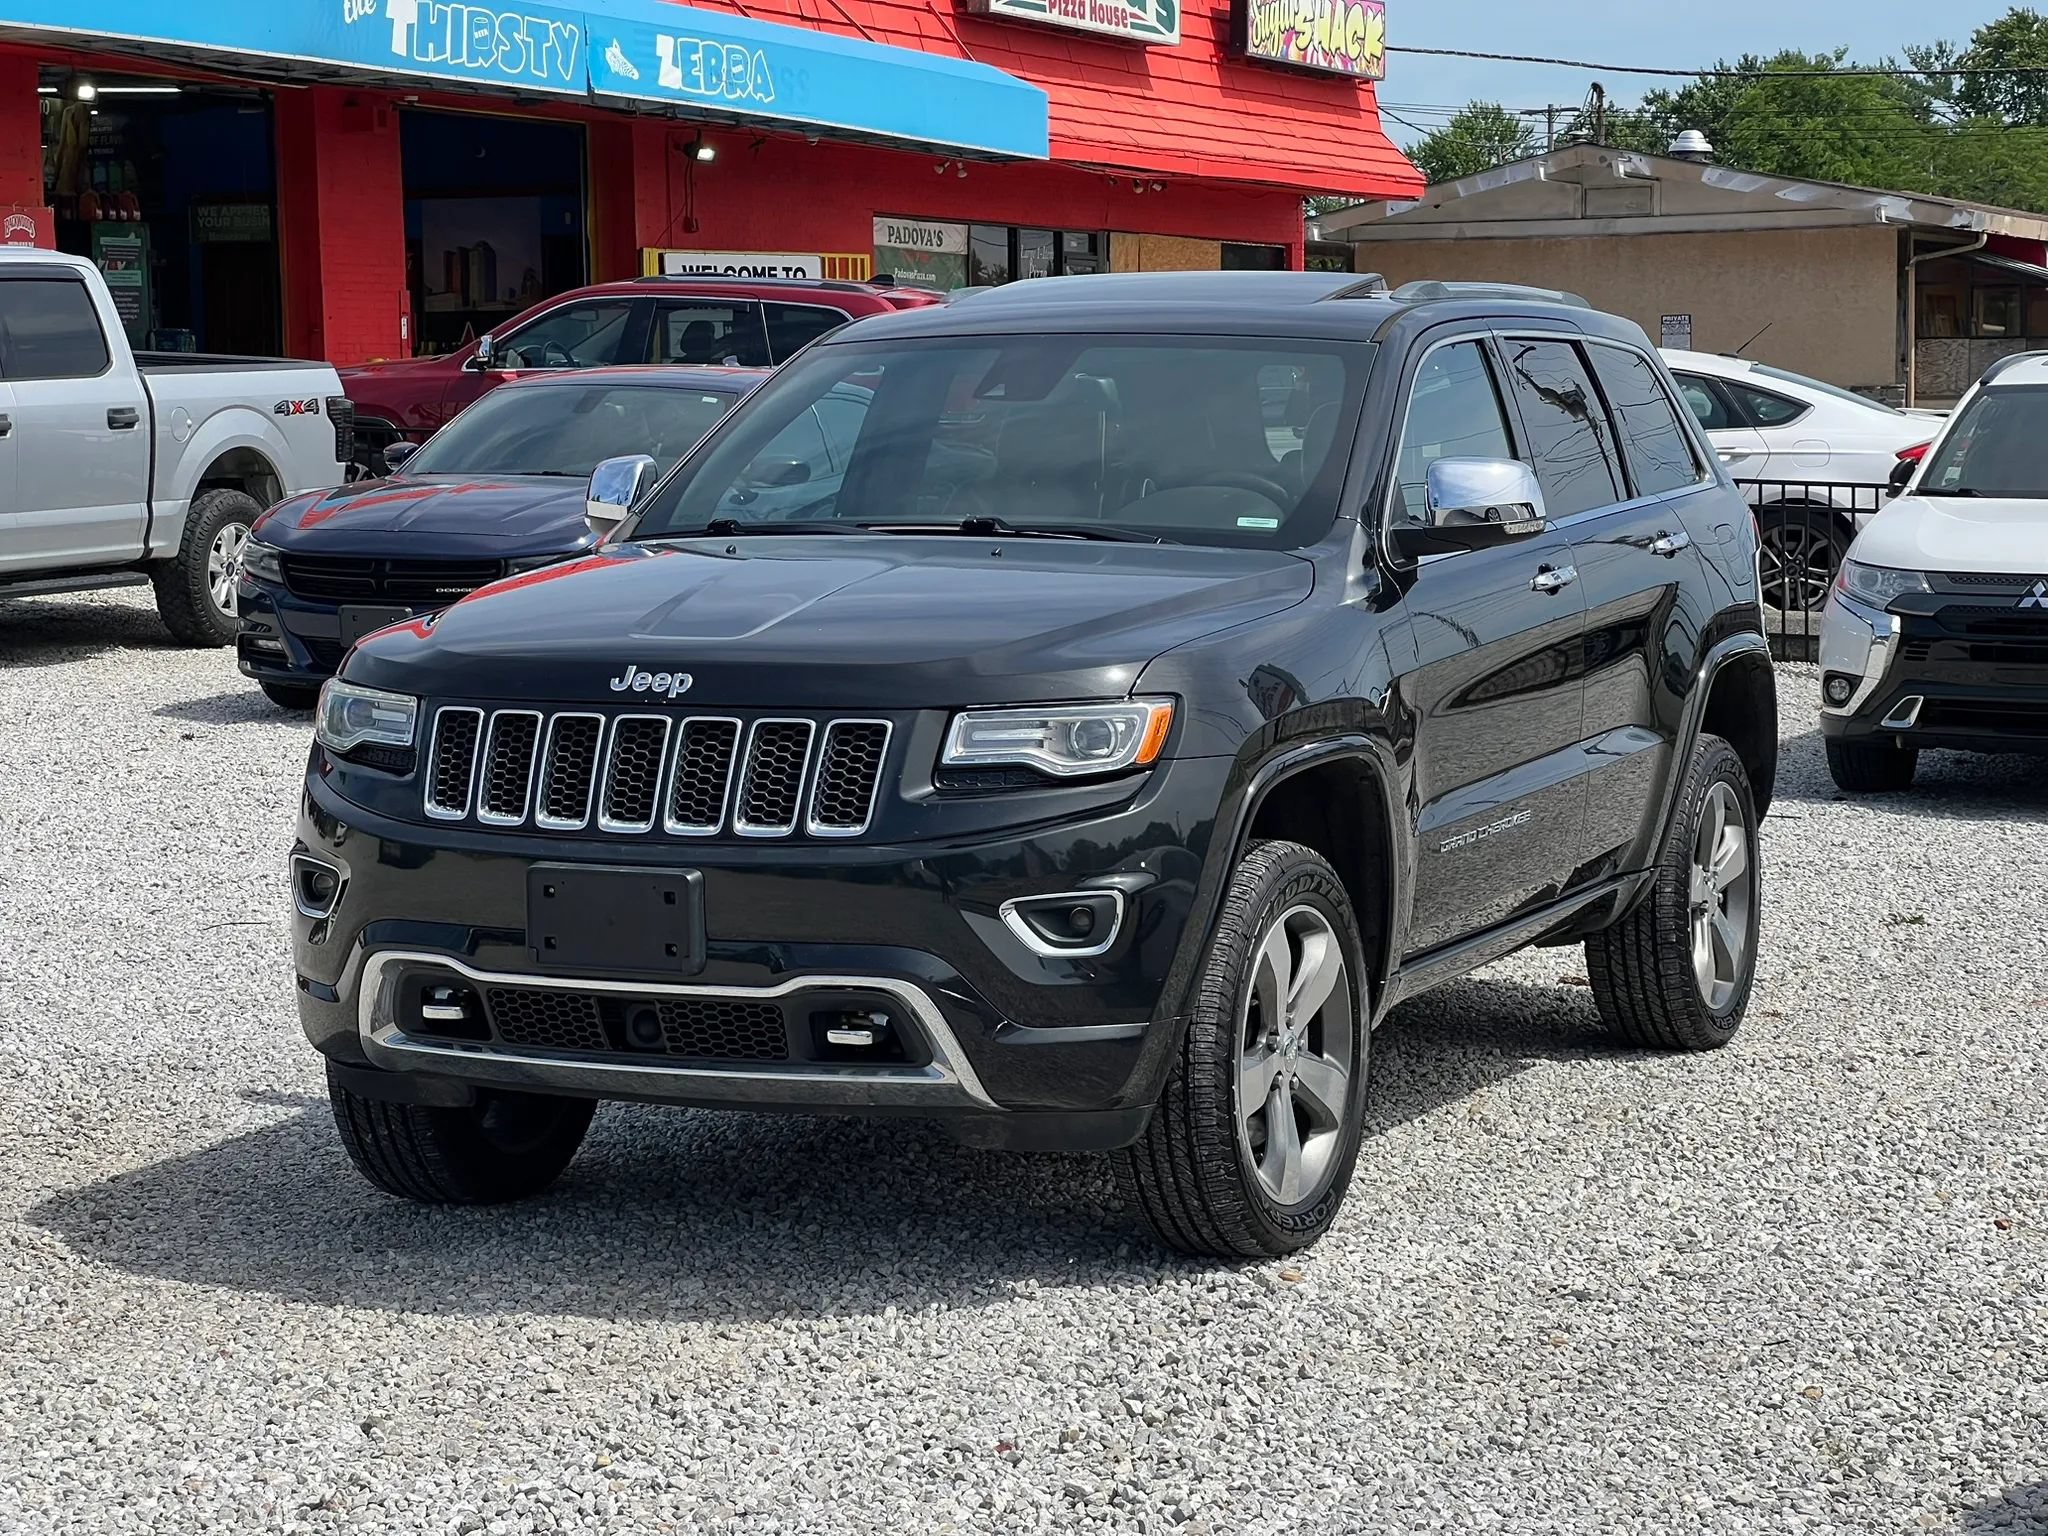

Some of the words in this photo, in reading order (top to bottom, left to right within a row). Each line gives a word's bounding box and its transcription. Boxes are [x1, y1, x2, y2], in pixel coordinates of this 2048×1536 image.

[1049, 0, 1087, 20] Pizza
[1090, 0, 1129, 28] House
[1294, 0, 1386, 63] SHACK
[343, 0, 377, 24] the
[386, 0, 580, 81] THIRSTY
[656, 33, 775, 103] ZEBRA
[887, 225, 944, 248] PADOVA'S
[610, 665, 693, 698] Jeep
[1440, 829, 1478, 853] GRAND
[1477, 810, 1532, 839] CHEROKEE
